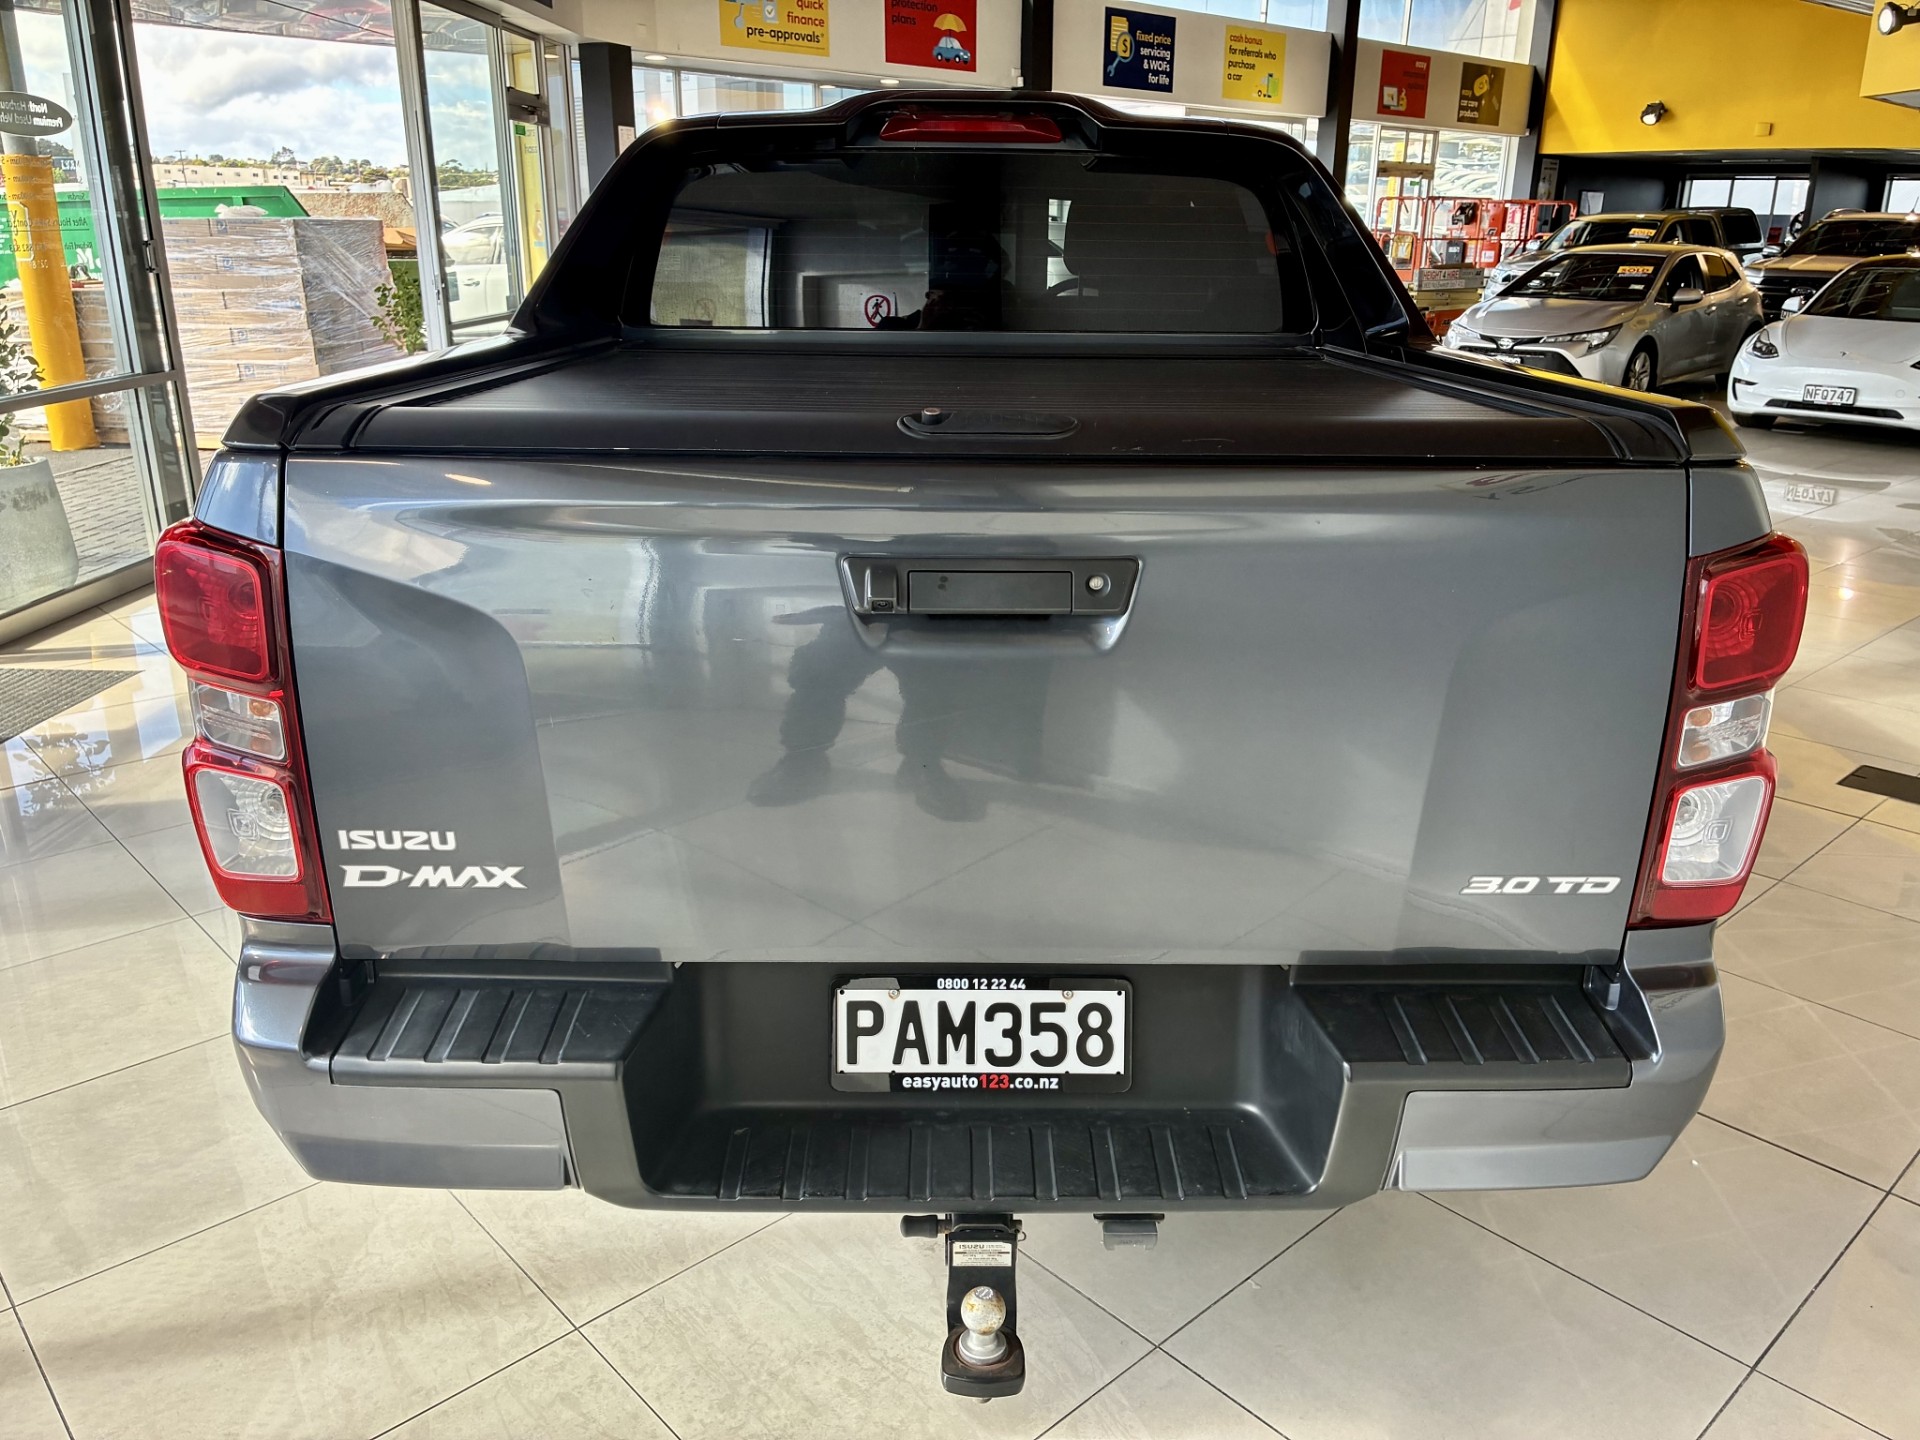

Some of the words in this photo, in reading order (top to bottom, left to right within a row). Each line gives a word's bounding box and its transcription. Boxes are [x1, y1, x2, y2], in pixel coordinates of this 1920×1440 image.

[796, 0, 825, 11] quick
[891, 0, 938, 12] protection
[787, 11, 825, 27] finance
[891, 13, 917, 25] plans
[1136, 30, 1154, 42] fixed
[1154, 33, 1172, 45] price
[1230, 33, 1243, 42] cash
[1244, 34, 1263, 45] bonus
[1140, 46, 1171, 60] servicing
[1229, 44, 1238, 55] for
[1238, 47, 1263, 58] referrals
[1263, 51, 1276, 60] who
[1143, 59, 1149, 69] &
[1149, 60, 1170, 72] WOFs
[1228, 60, 1255, 70] purchase
[1148, 73, 1158, 83] for
[1159, 74, 1170, 85] life
[1233, 73, 1243, 81] car
[1804, 387, 1853, 402] NFQ747
[337, 829, 457, 851] ISUZU
[1459, 876, 1540, 894] 3.0
[1547, 876, 1621, 894] TD
[937, 978, 969, 990] 0800
[972, 978, 988, 990] 12
[990, 978, 1007, 990] 22
[1009, 978, 1026, 990] 44
[846, 1000, 1114, 1067] PAM358
[902, 1074, 1059, 1091] easyauto123.co.nz
